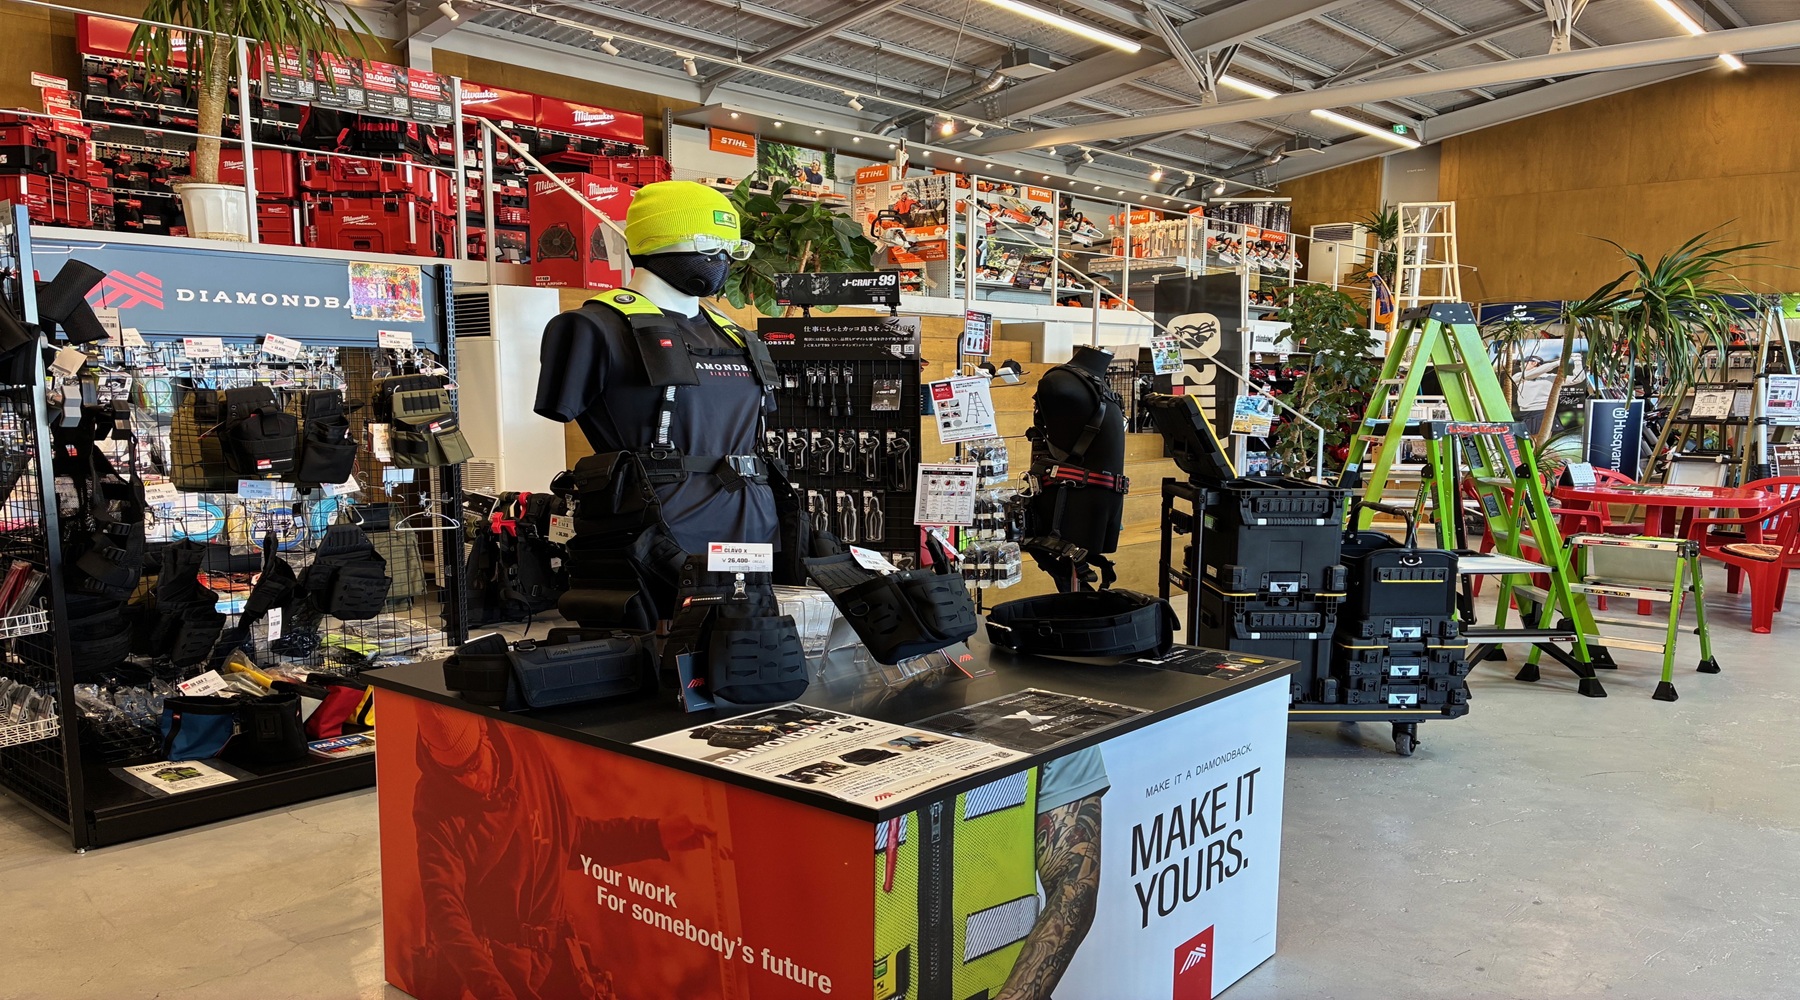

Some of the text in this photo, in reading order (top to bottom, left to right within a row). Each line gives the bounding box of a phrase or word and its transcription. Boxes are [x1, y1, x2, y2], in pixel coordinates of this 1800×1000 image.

[460, 87, 499, 100] ilwaukee
[572, 109, 616, 123] Milwaukee
[720, 136, 748, 148] STIHL
[859, 169, 885, 179] STIHL
[587, 181, 619, 198] Milwaukee
[1030, 188, 1051, 199] STIHL
[341, 214, 371, 224] Milwaukee
[1262, 233, 1284, 241] STIHL
[842, 274, 897, 287] J-CRAFT 99
[1609, 419, 1627, 474] Husqvarna
[721, 715, 852, 766] DIAMONDBACK
[1145, 778, 1170, 798] MAKE
[1174, 773, 1182, 786] IT
[1185, 769, 1192, 781] A
[1130, 767, 1261, 878] MAKE IT
[580, 854, 677, 909] Your work
[1134, 829, 1249, 930] YOURS.
[597, 885, 832, 994] For somebody's future
